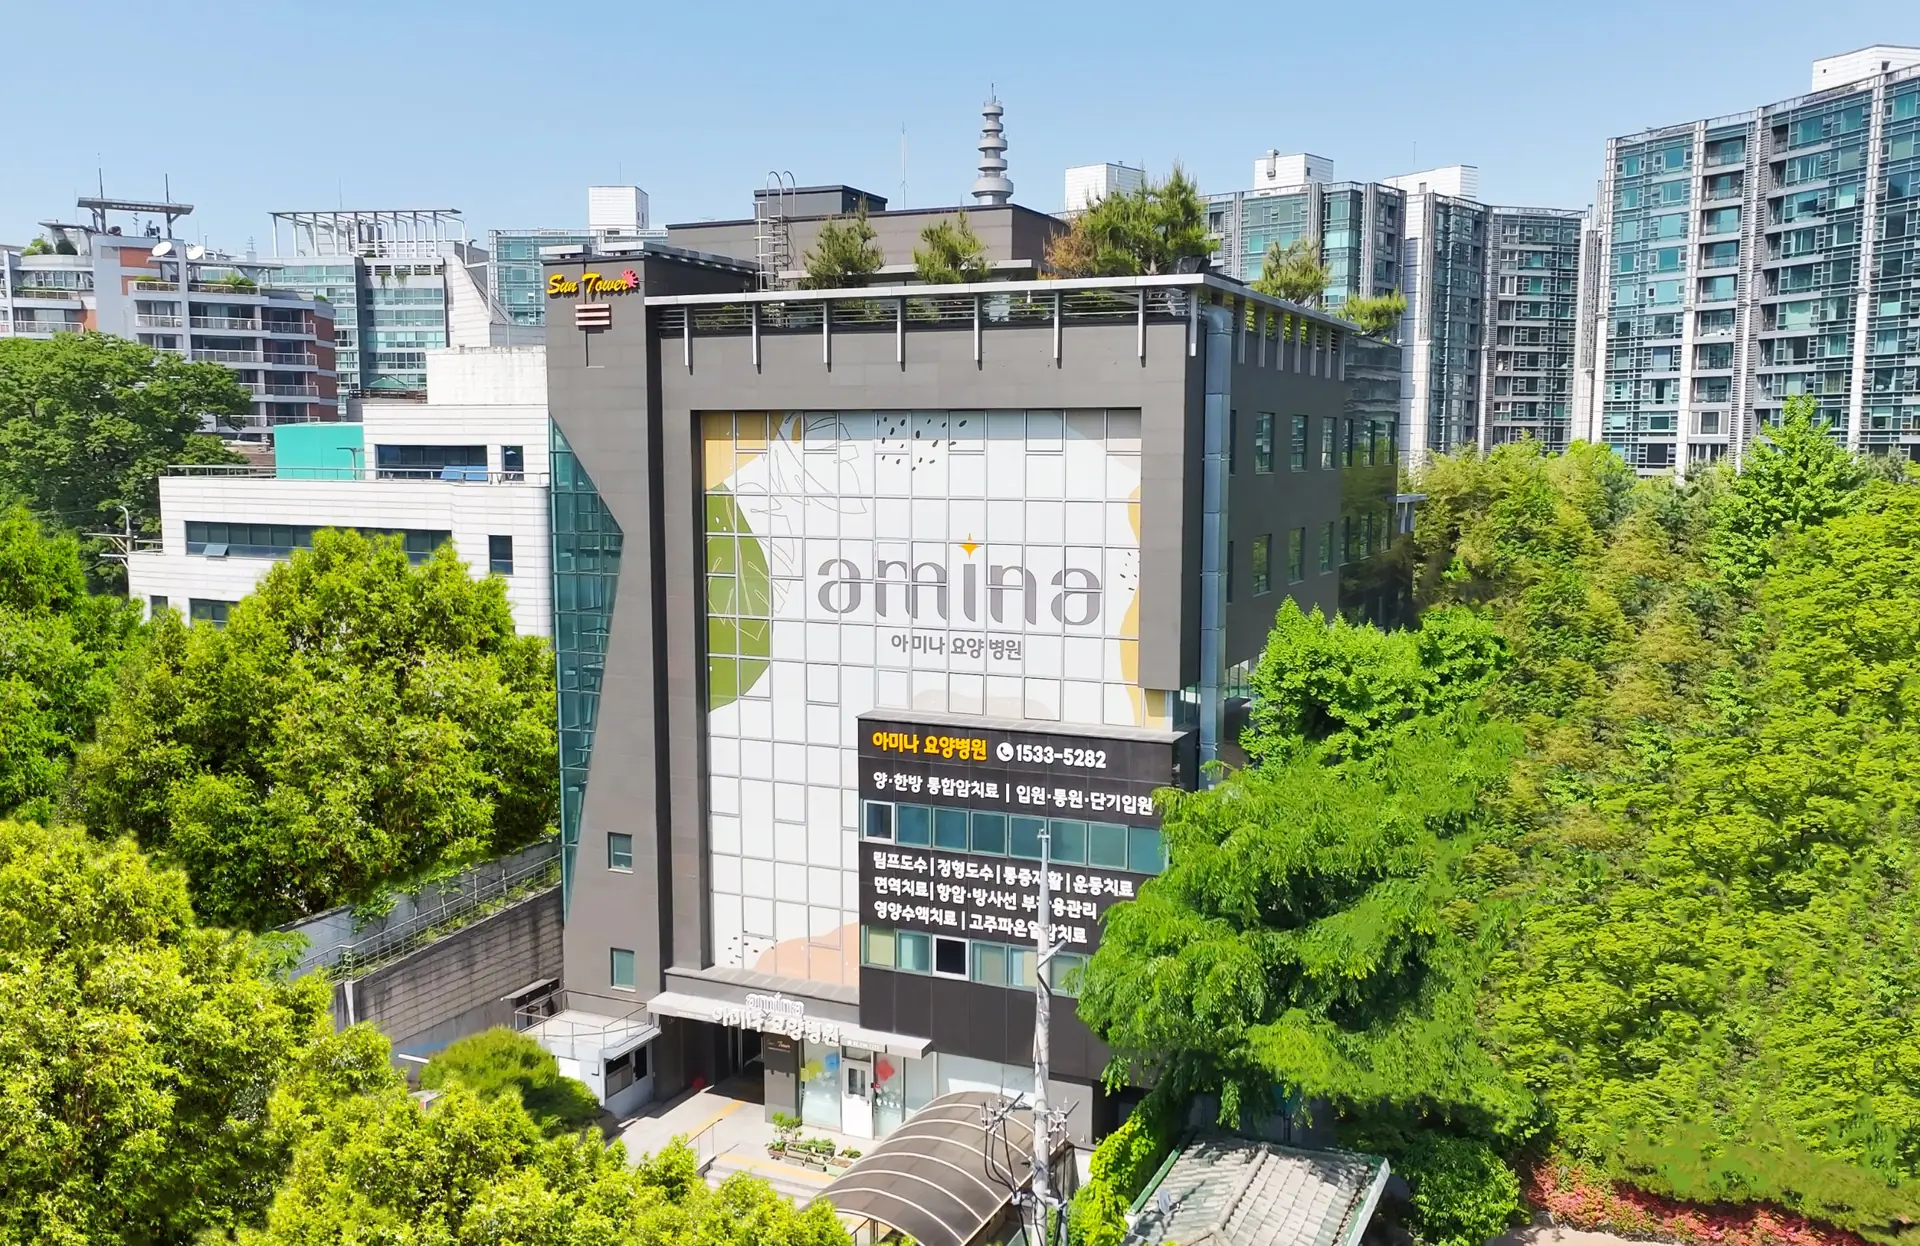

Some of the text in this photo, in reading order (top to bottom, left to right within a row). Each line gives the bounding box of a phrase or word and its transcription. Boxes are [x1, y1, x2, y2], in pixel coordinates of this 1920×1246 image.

[546, 272, 628, 294] Sun Tower
[817, 534, 1101, 626] amina
[891, 634, 1022, 661] 아미나 요양병원
[872, 732, 1107, 769] 아미나 요양병원 1533-5282
[926, 776, 1000, 799] 통합암치료
[873, 851, 929, 873] 림프도수
[937, 859, 995, 881] 정형도수
[1073, 875, 1135, 897] 운동치료
[873, 900, 958, 926] 영양수액치료
[874, 876, 929, 897] 면역치료
[1021, 894, 1097, 920] 부용관리
[745, 992, 805, 1016] amina
[711, 1007, 765, 1033] 아미나
[764, 1015, 841, 1048] 요양병원
